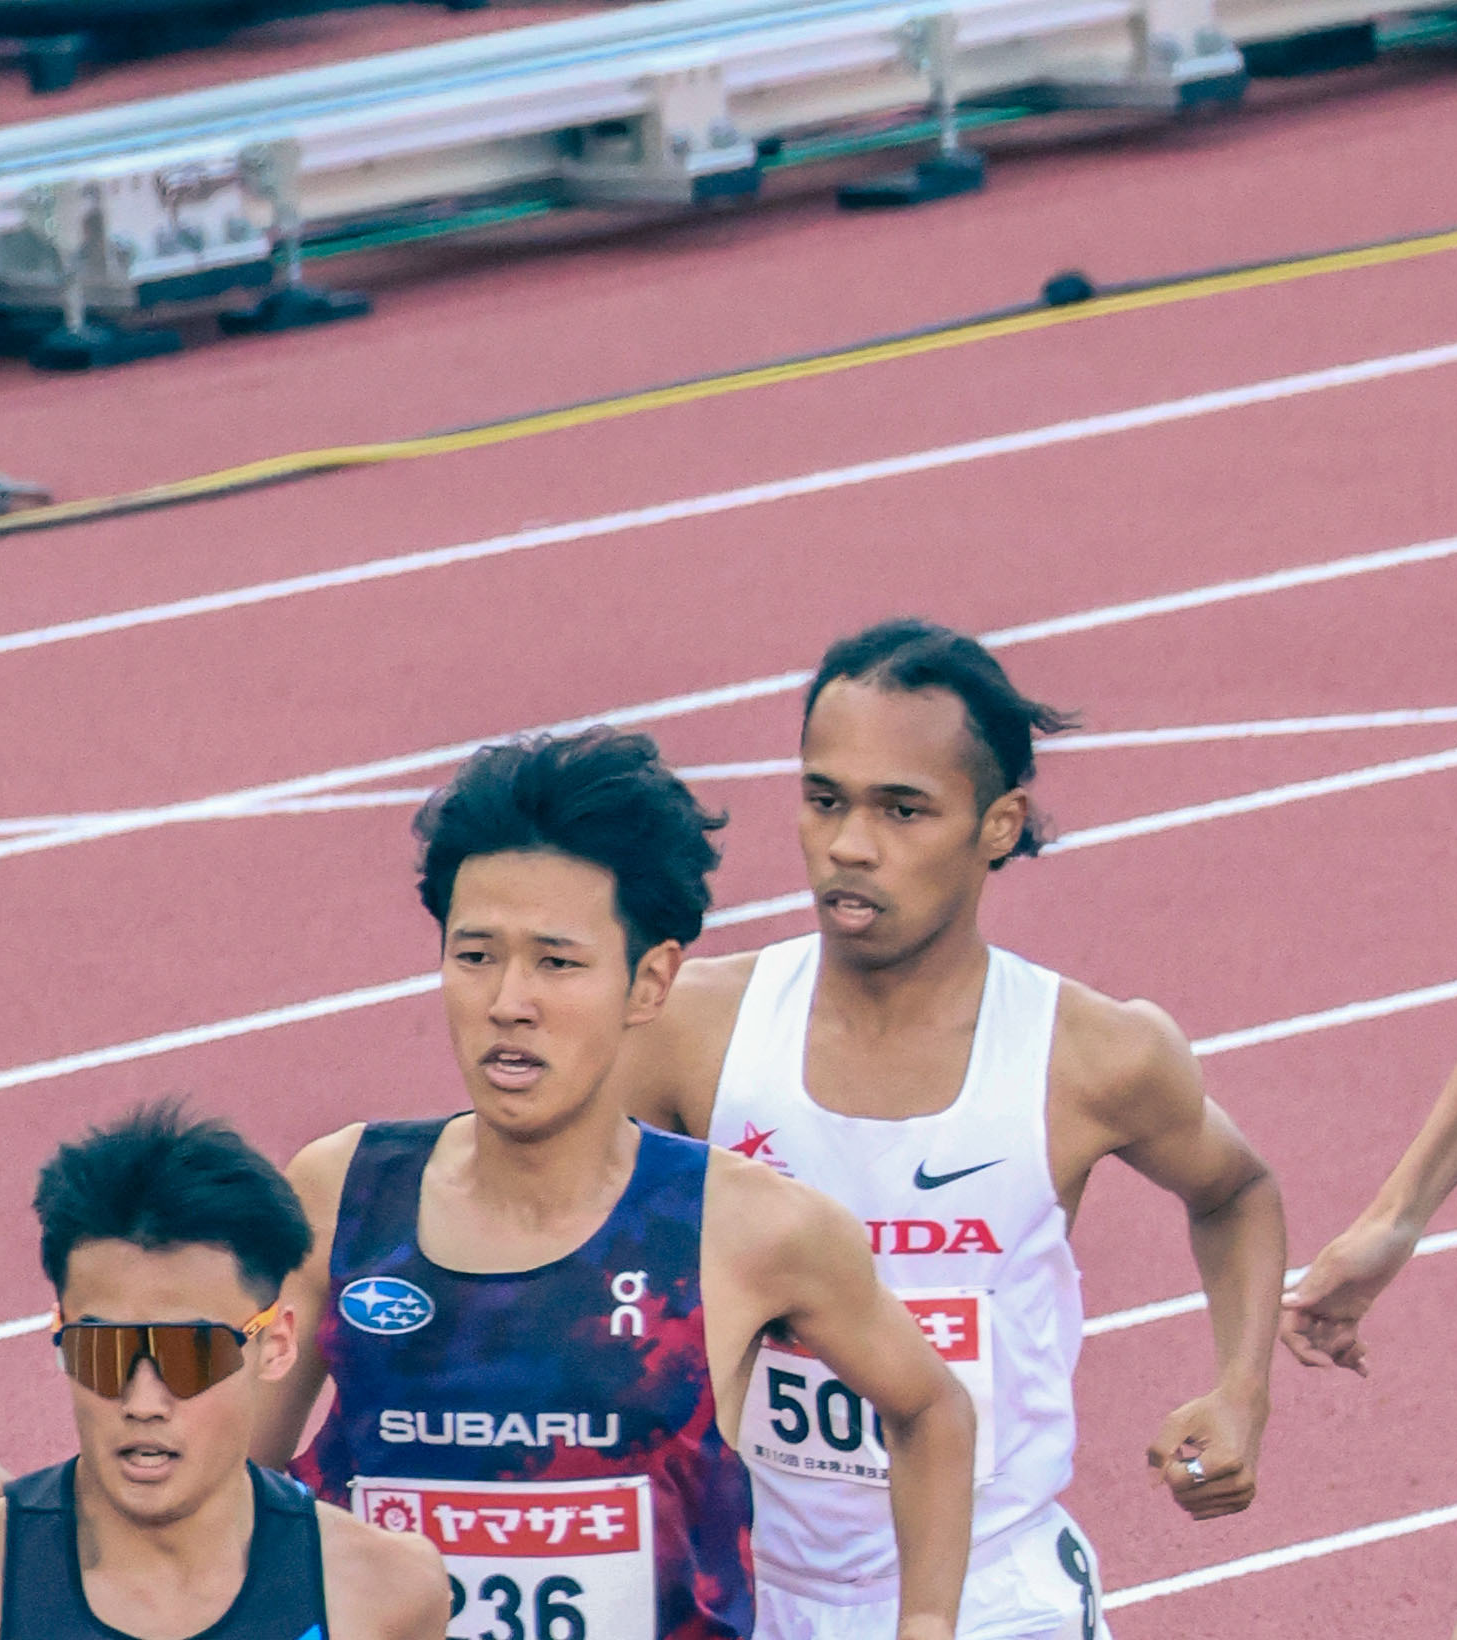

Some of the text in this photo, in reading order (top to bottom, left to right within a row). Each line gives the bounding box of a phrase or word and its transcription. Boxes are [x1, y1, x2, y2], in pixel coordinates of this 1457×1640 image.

[379, 1409, 620, 1447] SUBARU
[432, 1504, 626, 1545] ヤマザキ
